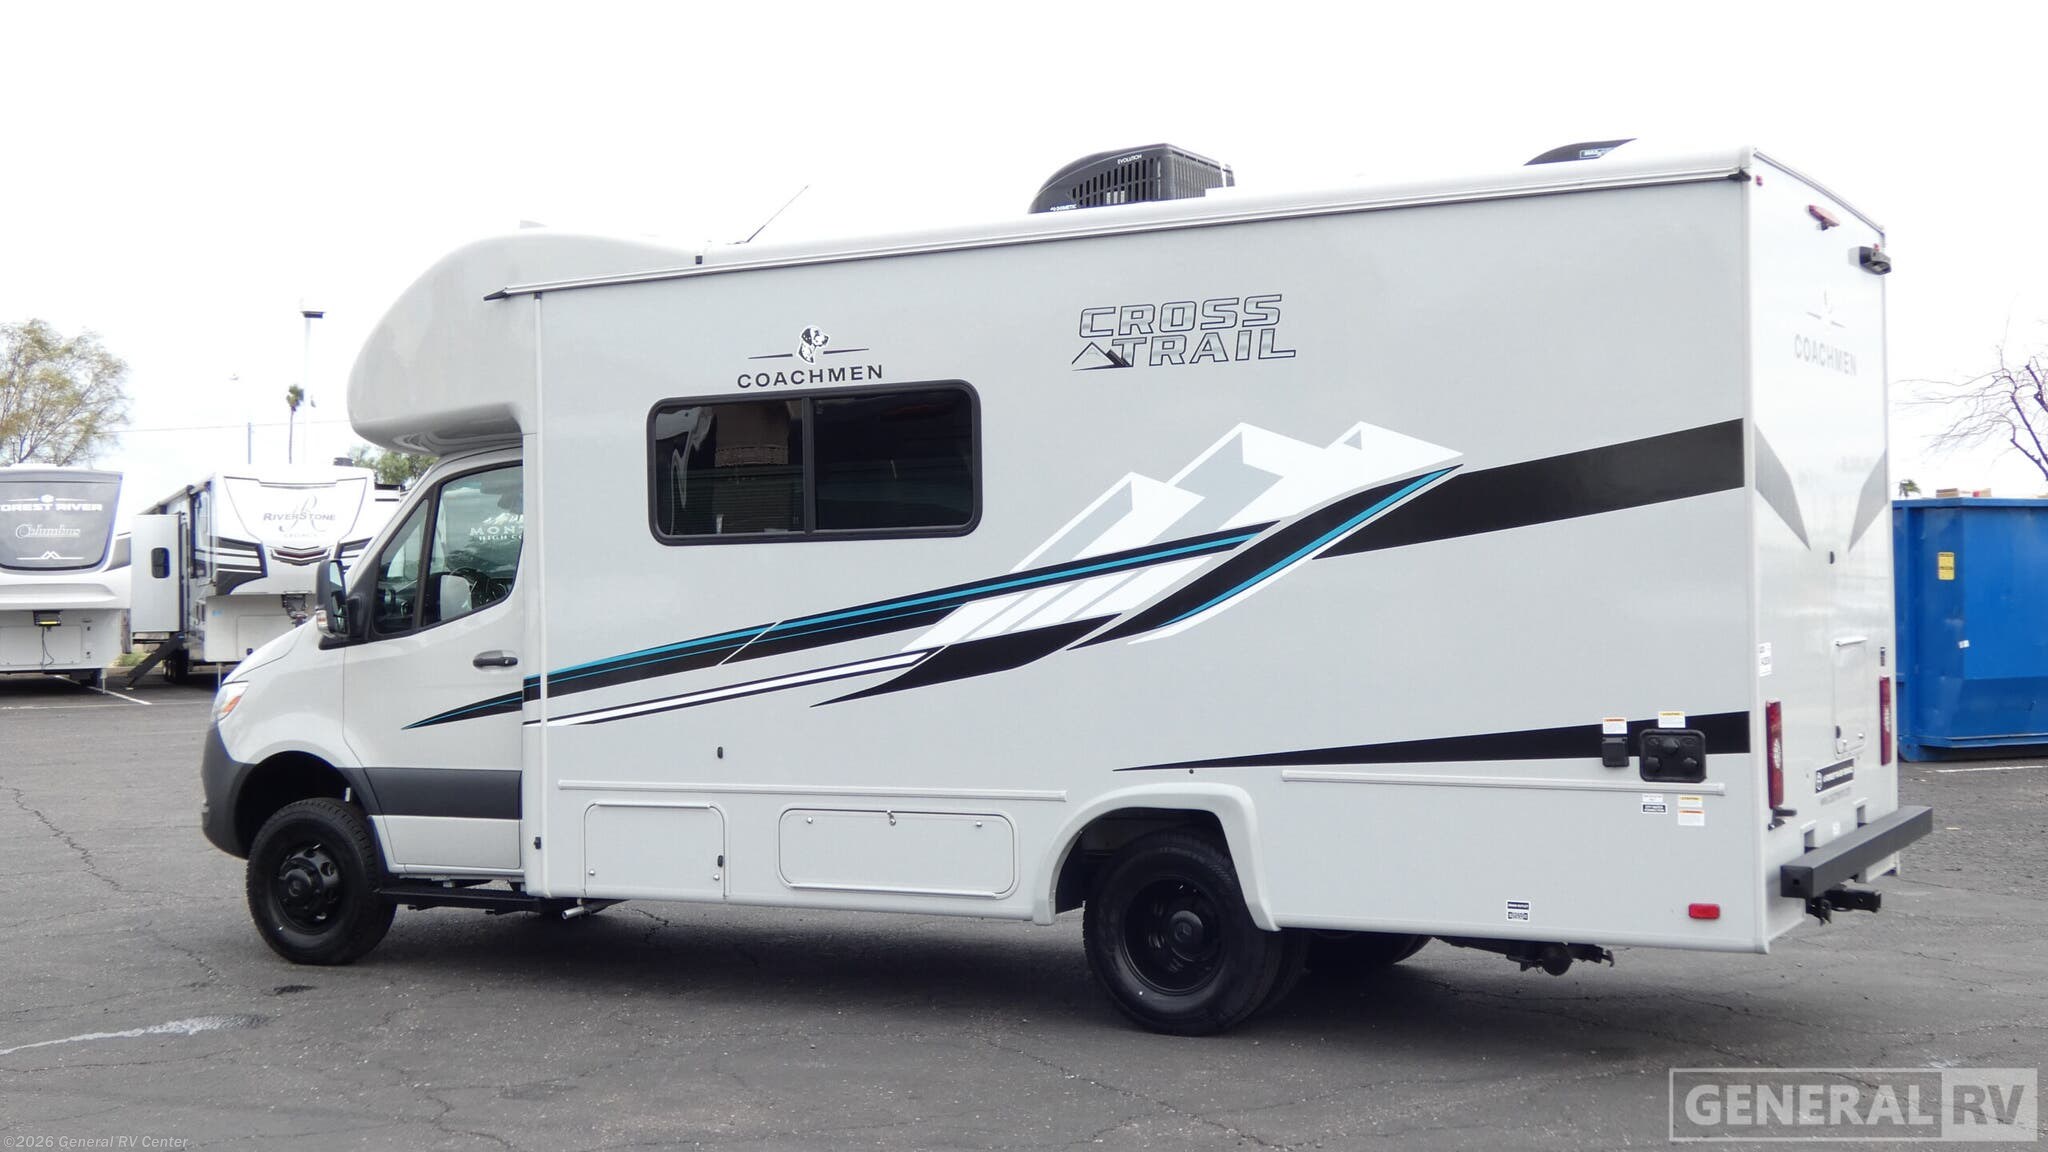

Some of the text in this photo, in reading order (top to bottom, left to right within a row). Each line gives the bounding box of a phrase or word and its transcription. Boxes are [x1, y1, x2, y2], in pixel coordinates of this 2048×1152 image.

[1079, 294, 1283, 338] CROSS
[1111, 328, 1297, 368] TRAIL
[1794, 334, 1857, 376] COACHMEN
[737, 364, 883, 388] COACHMEN
[0, 503, 103, 511] OREST RIVER
